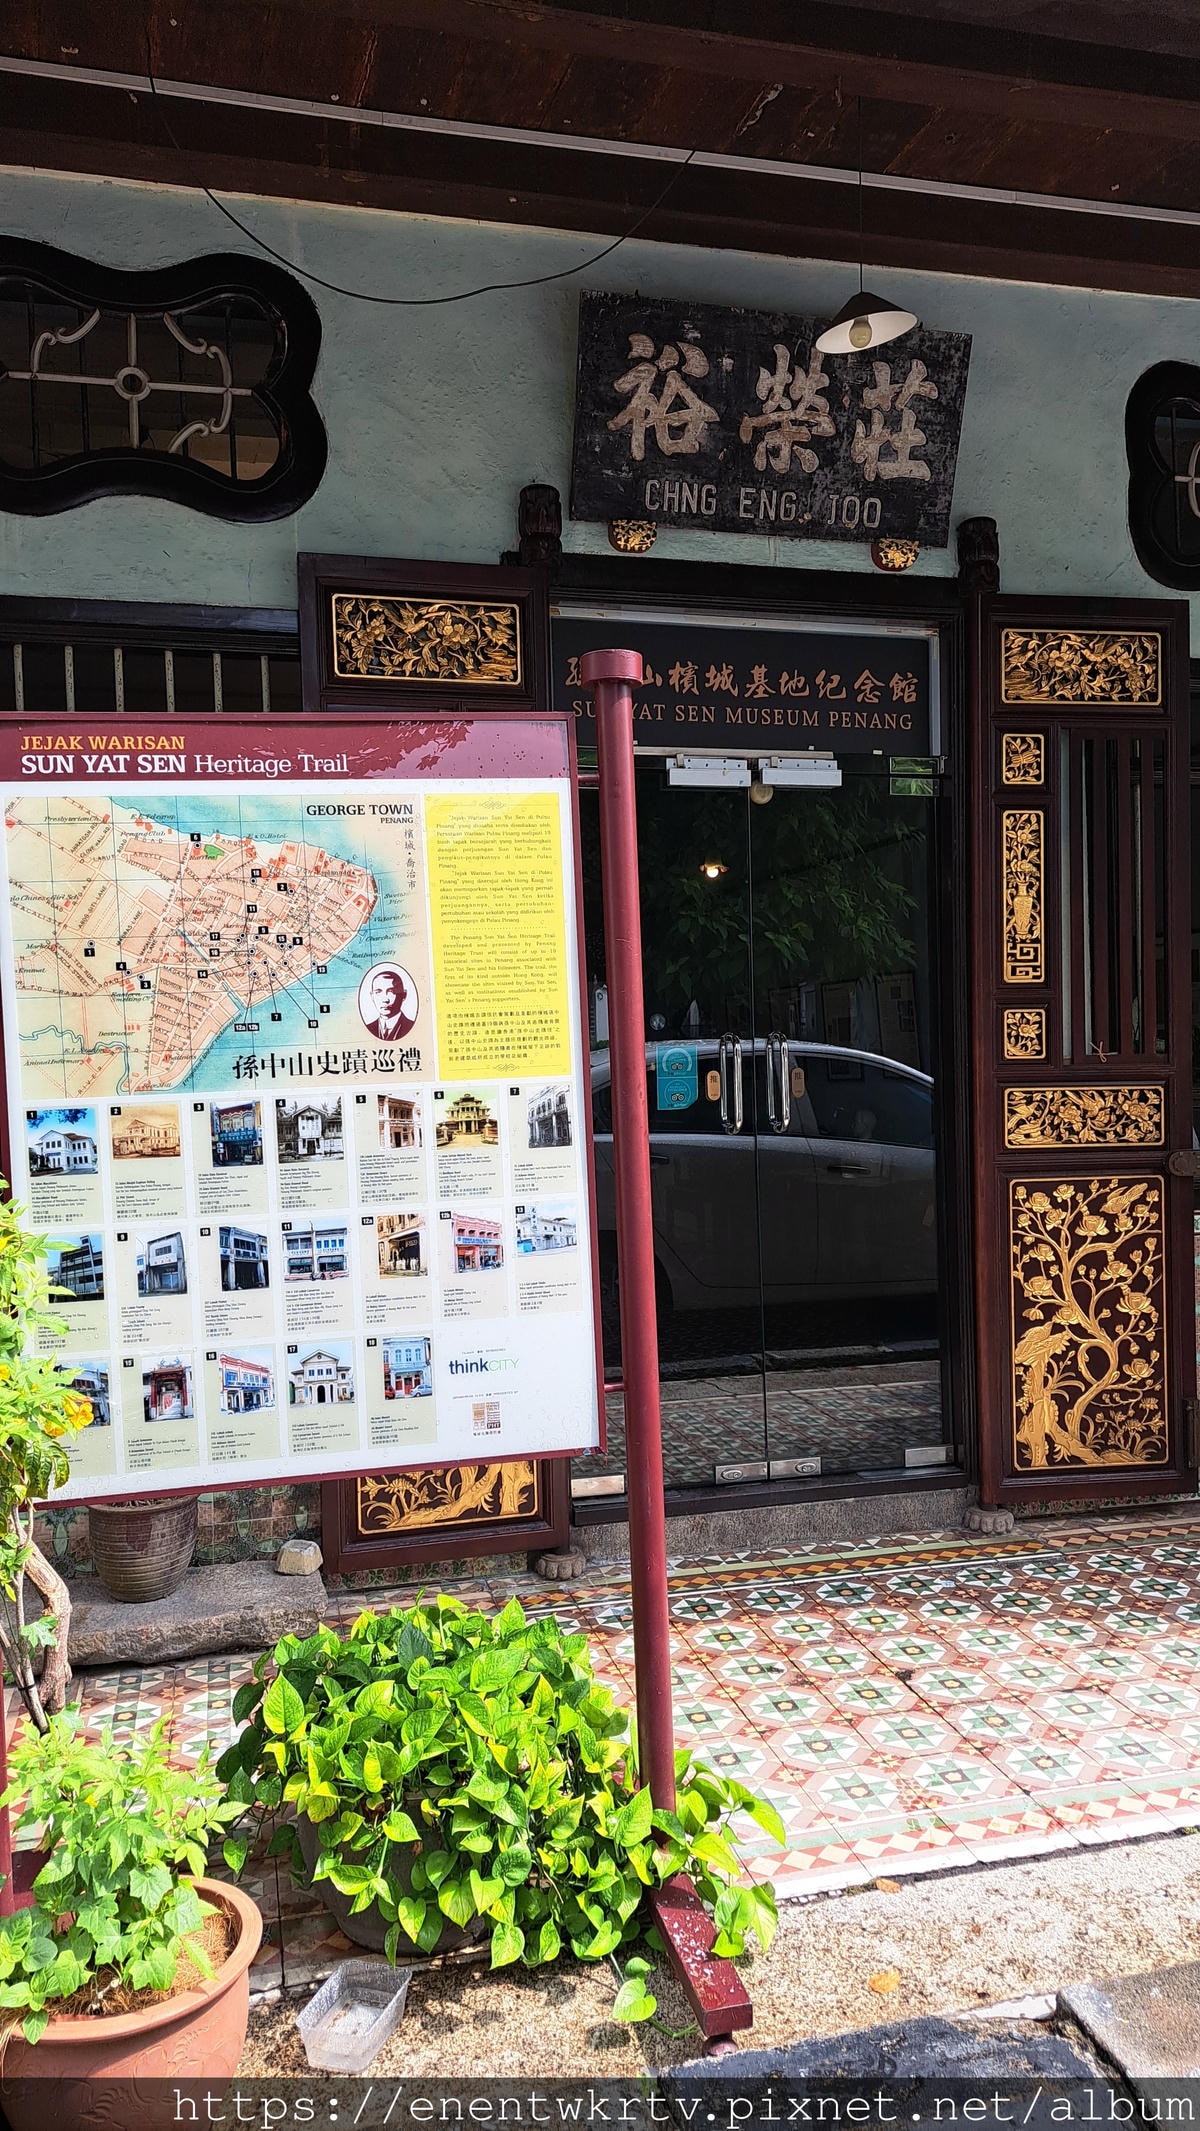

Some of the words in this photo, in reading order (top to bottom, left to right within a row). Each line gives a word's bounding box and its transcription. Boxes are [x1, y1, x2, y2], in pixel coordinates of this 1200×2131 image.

[645, 479, 717, 516] CHNG
[827, 494, 882, 528] JOO
[572, 700, 596, 718] SU
[675, 704, 716, 723] SEN
[726, 707, 819, 727] MUSEUM
[828, 711, 913, 730] PENANG
[21, 736, 82, 752] JEJAK
[86, 736, 185, 750] WARISAN
[21, 756, 74, 774] SUN
[85, 756, 132, 774] YAT
[136, 754, 186, 774] SEN
[194, 754, 290, 777] Heritage
[298, 754, 349, 772] Trail
[306, 804, 365, 816] GEORGE
[369, 804, 413, 815] TOWN
[232, 1048, 422, 1079] 孫中山史蹟巡禮
[202, 1228, 209, 1236] 10
[284, 1222, 290, 1231] 11
[449, 1358, 519, 1374] thinkCITY
